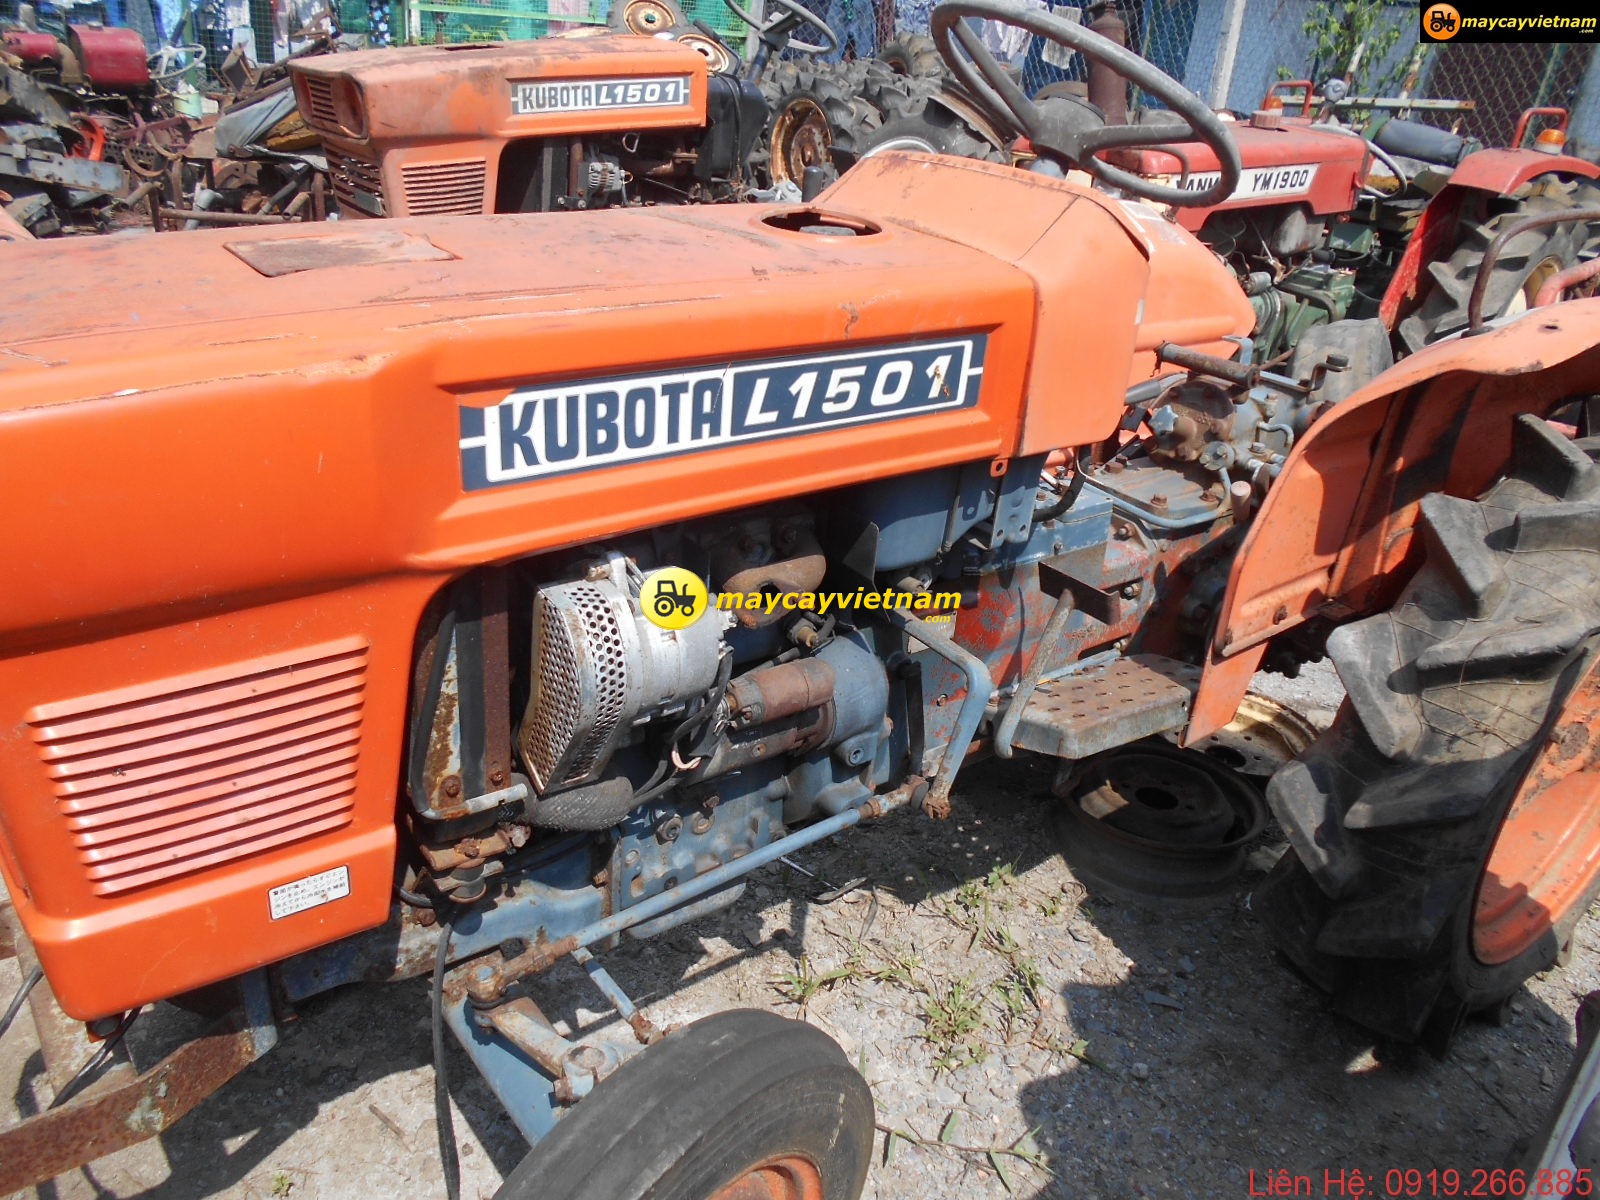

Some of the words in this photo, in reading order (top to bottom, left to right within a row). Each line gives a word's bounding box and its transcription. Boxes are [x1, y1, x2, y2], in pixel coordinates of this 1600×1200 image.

[522, 85, 592, 109] KUBOTA
[599, 83, 676, 104] L1501
[1251, 169, 1309, 192] YM1900
[500, 377, 724, 471] KUBOTA
[744, 355, 952, 427] L1501
